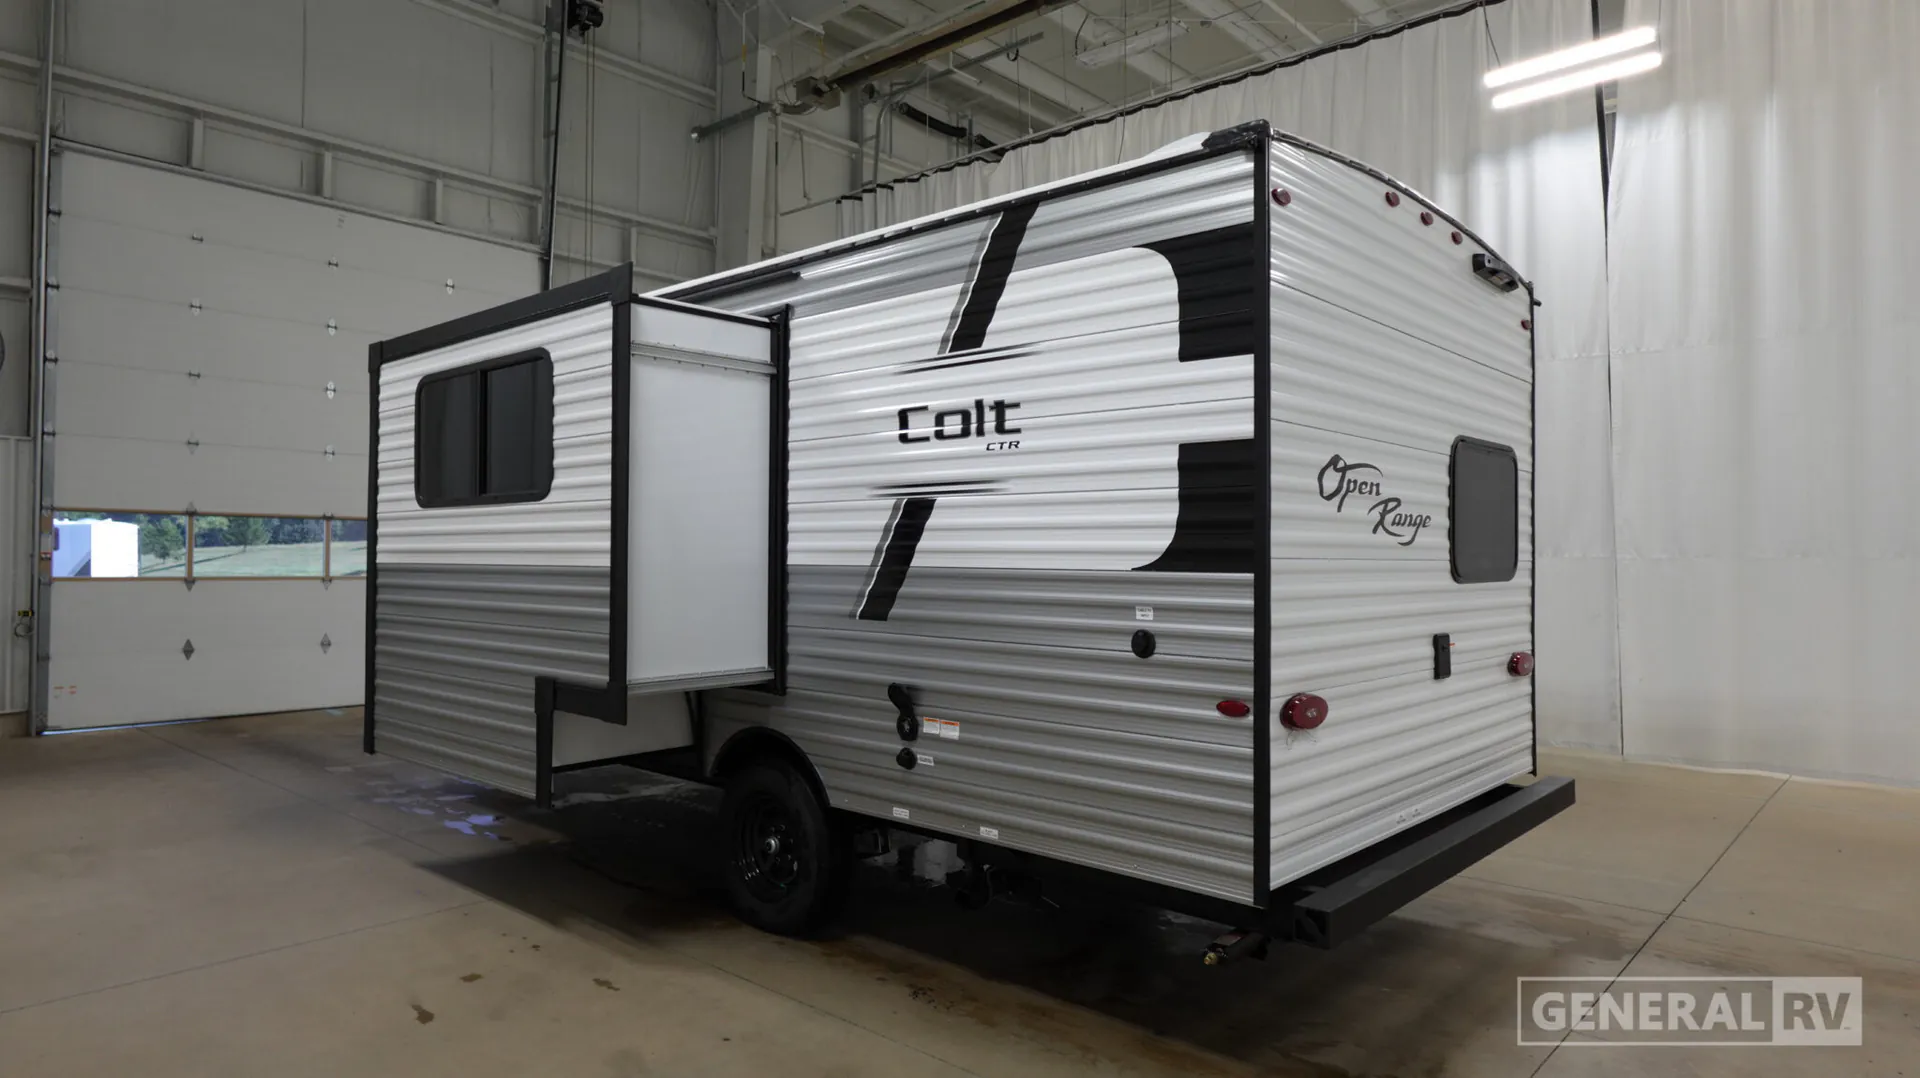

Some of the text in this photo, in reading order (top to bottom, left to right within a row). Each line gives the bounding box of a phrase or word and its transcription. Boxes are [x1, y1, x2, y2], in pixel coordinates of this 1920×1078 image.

[898, 398, 1022, 444] Colt
[986, 440, 1021, 451] CTR
[1317, 454, 1384, 513] Open
[1367, 497, 1432, 546] Range
